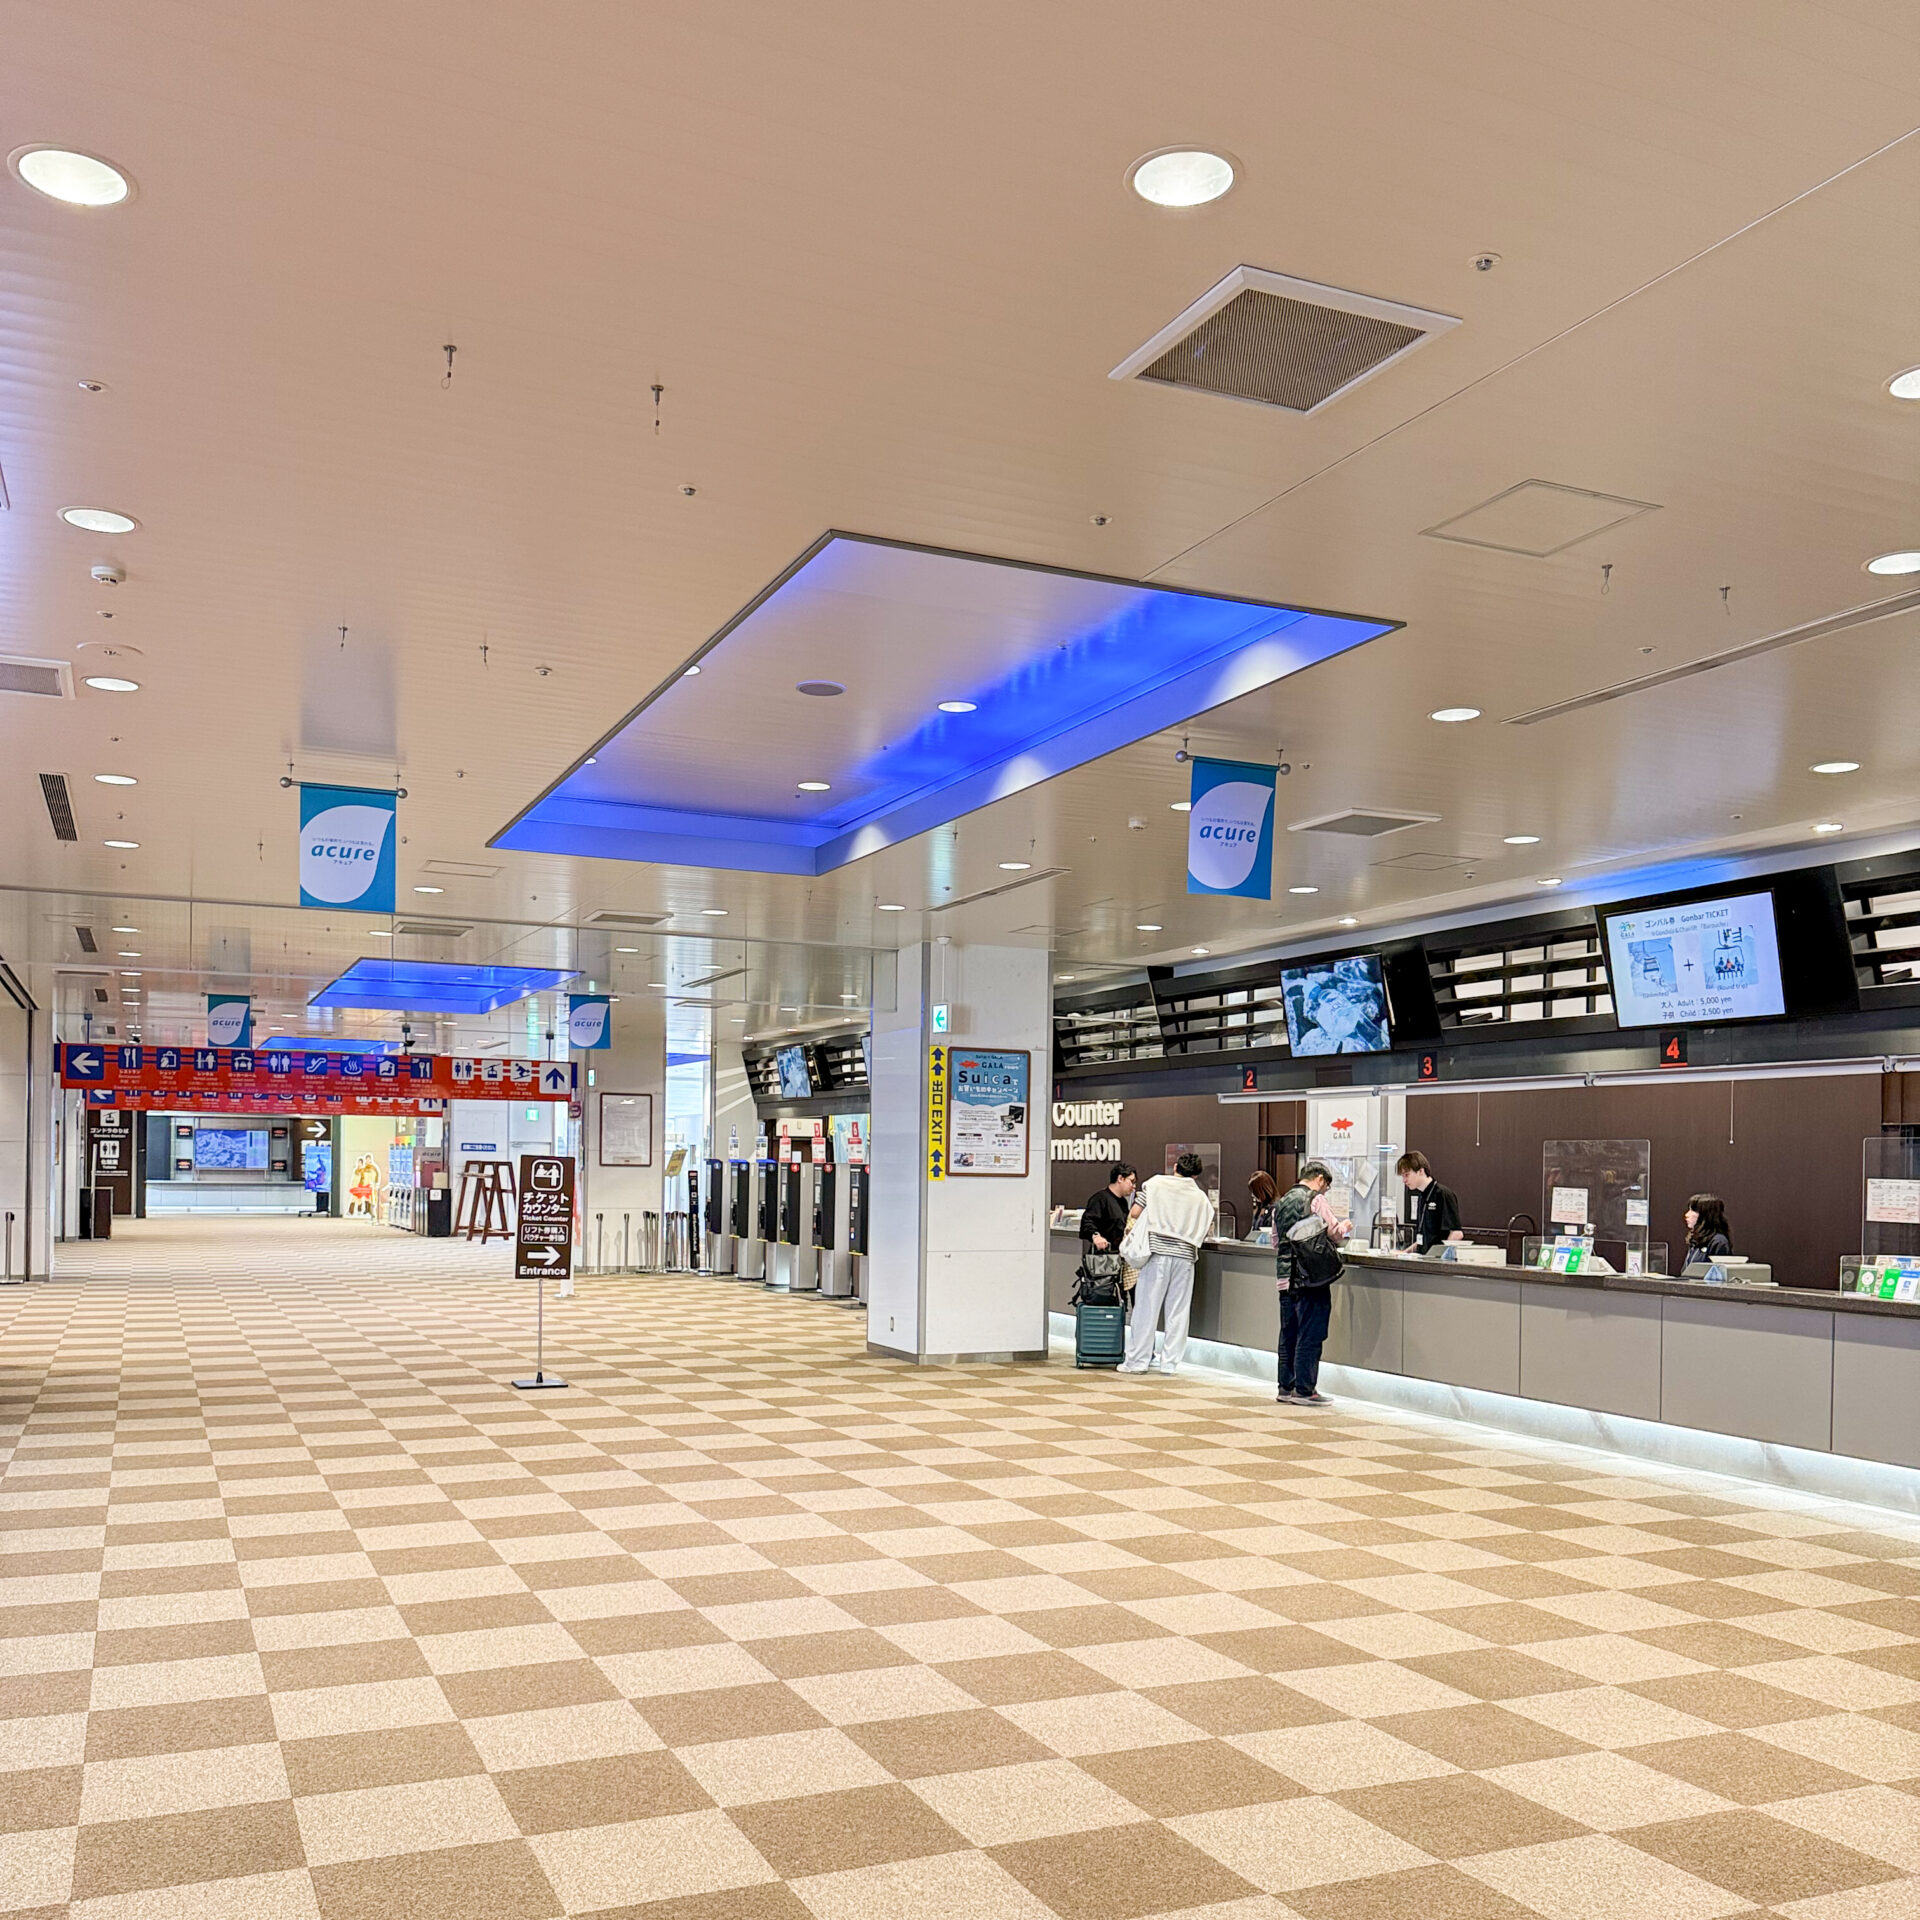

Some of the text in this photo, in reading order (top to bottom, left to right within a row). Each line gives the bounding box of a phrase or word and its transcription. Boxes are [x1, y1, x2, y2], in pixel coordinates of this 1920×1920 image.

[1199, 825, 1256, 843] acure
[311, 844, 375, 861] acure
[1705, 909, 1729, 919] TICKET
[1661, 1001, 1674, 1009] 大人
[1699, 996, 1719, 1005] 5,000
[1721, 996, 1733, 1005] yen
[1680, 1009, 1697, 1018] Child
[1702, 1007, 1721, 1017] 2,500
[1722, 1006, 1734, 1016] yen
[212, 1019, 242, 1027] acure
[574, 1020, 602, 1028] acure
[1666, 1036, 1681, 1060] 4
[1423, 1056, 1433, 1076] 3
[1246, 1069, 1254, 1087] 2
[1056, 1084, 1061, 1098] 1
[931, 1080, 943, 1145] 出口 EXIT
[1052, 1099, 1124, 1128] Counter
[523, 1192, 570, 1204] チケット
[522, 1203, 570, 1214] カウンター
[519, 1265, 567, 1275] Entrance
